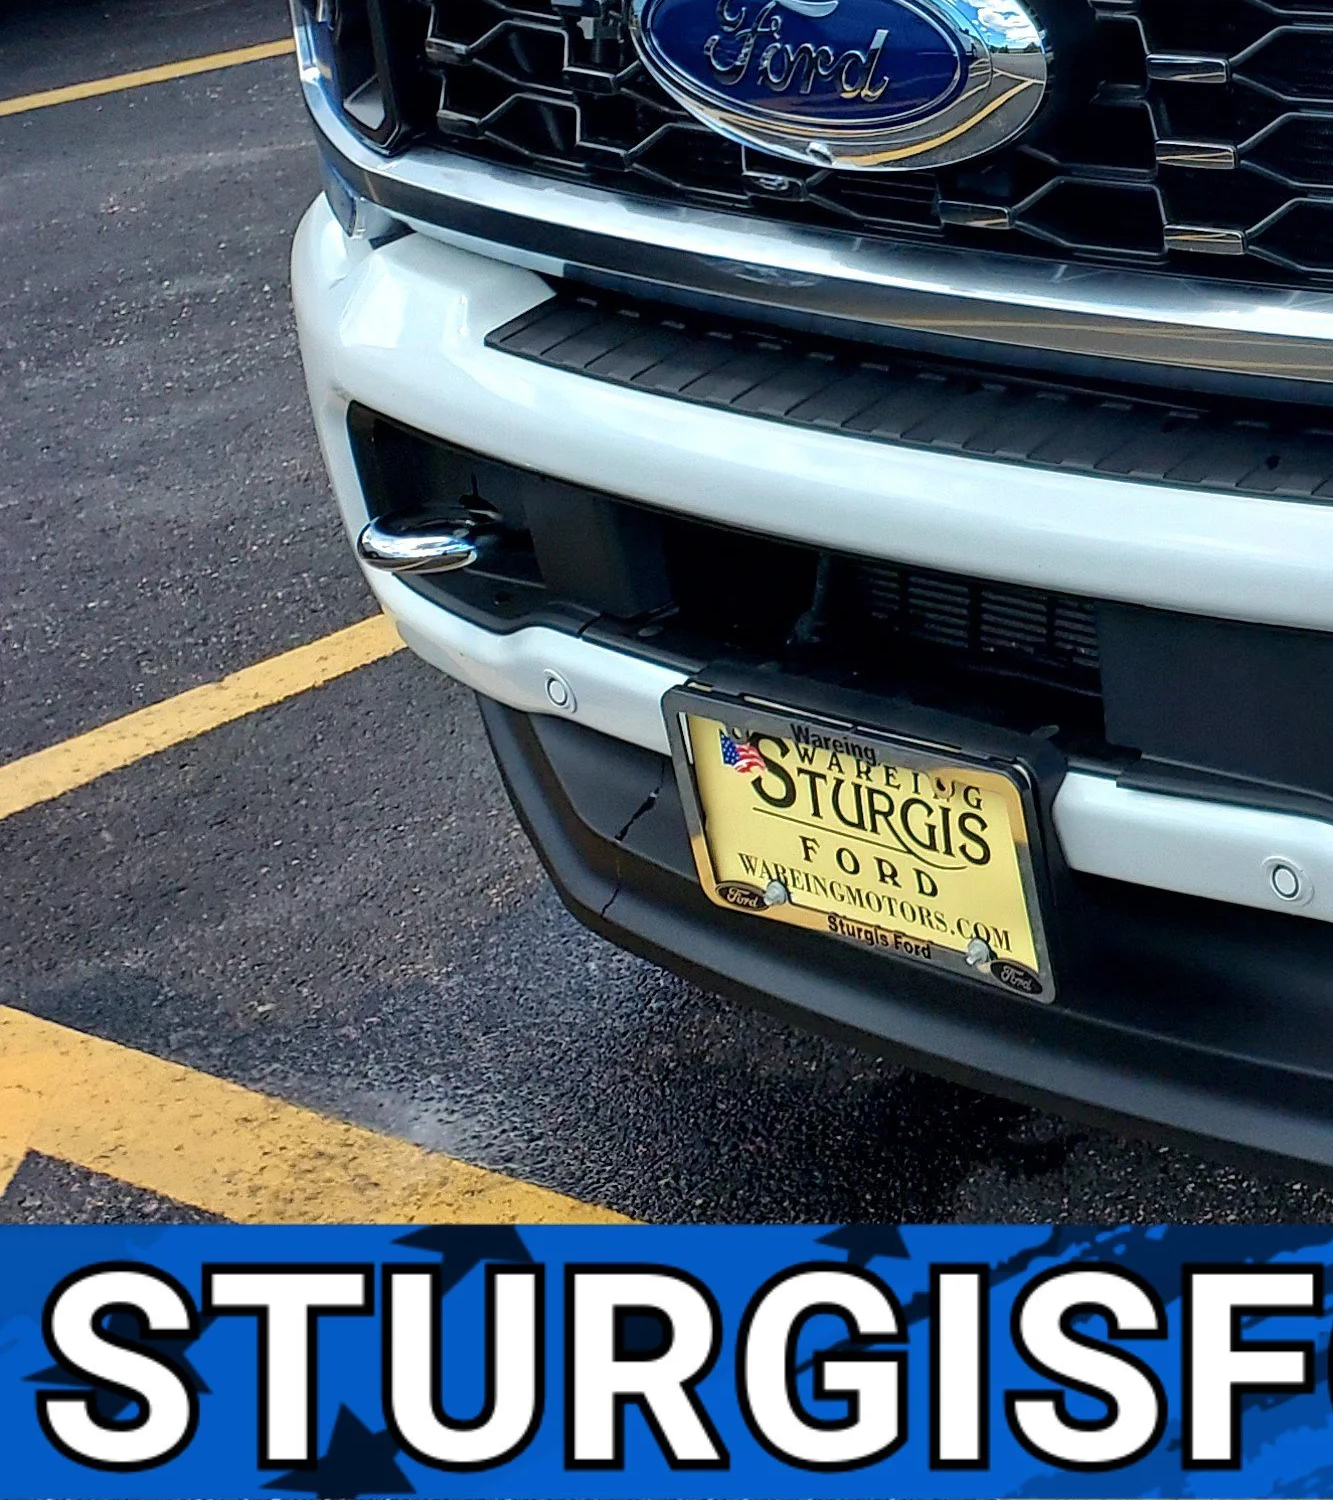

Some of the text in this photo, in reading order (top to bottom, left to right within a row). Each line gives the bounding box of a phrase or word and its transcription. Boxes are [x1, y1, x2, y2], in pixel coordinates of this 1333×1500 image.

[790, 723, 878, 767] Wareing
[751, 731, 992, 868] STURGIS
[798, 835, 939, 898] FORD
[726, 886, 761, 909] Ford
[827, 915, 932, 960] Sturgis Ford
[999, 963, 1034, 993] Ford
